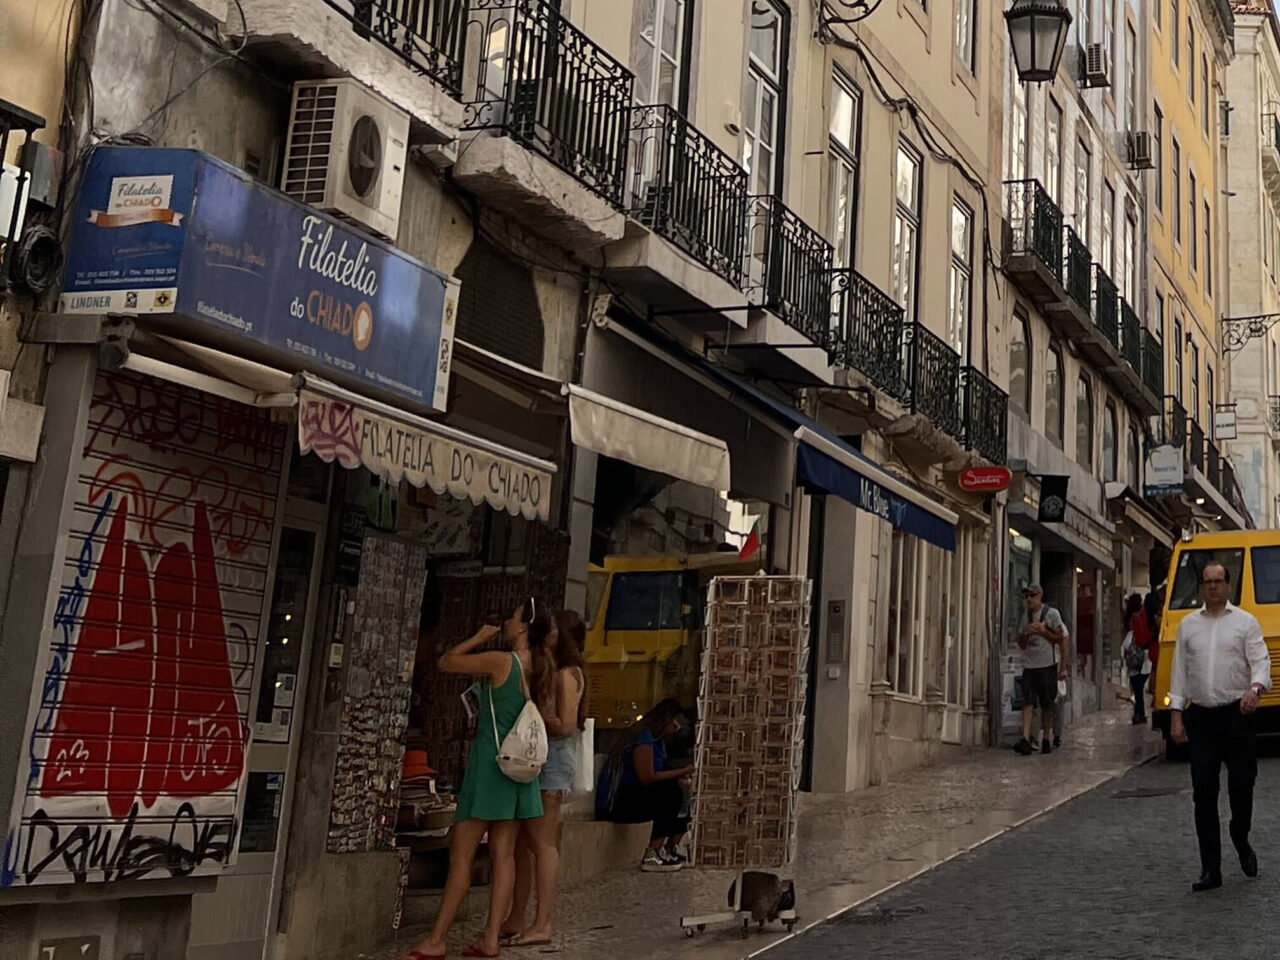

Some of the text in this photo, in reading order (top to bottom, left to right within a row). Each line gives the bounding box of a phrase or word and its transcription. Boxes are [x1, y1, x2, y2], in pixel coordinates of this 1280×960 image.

[117, 182, 163, 197] Filatelia
[123, 196, 162, 208] CHIADO
[298, 215, 378, 296] Filatelia
[70, 295, 111, 309] LINDNER
[290, 290, 373, 351] do CHIADO
[360, 418, 436, 476] FILATELIA
[451, 448, 475, 485] DO
[488, 462, 541, 507] CHIADO
[859, 478, 889, 519] Mr. Blue
